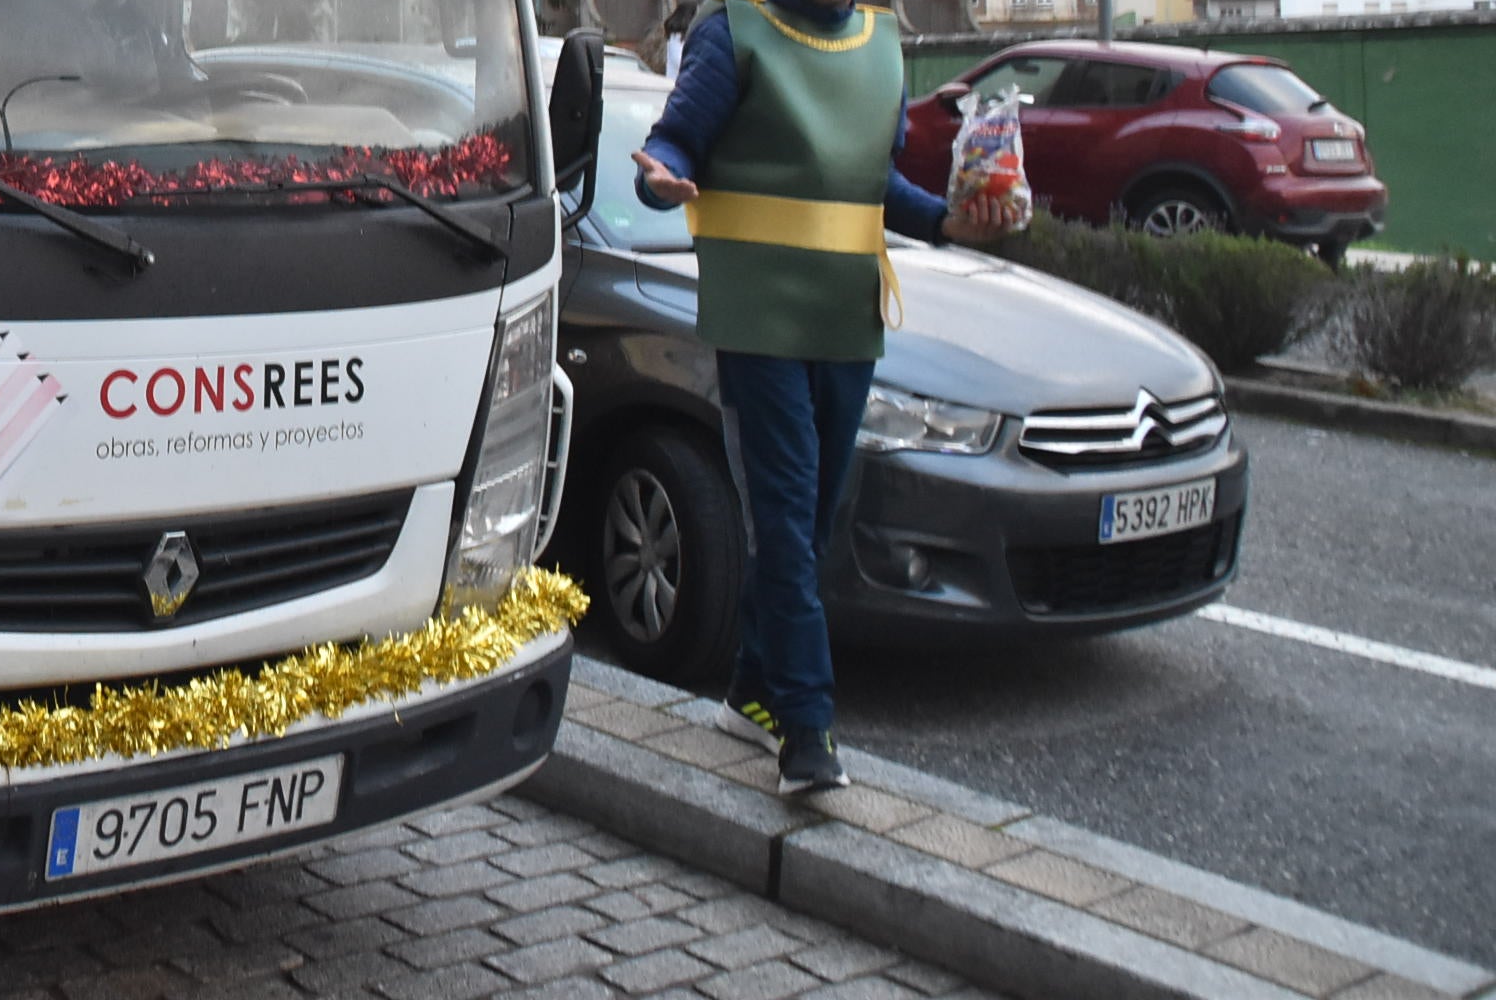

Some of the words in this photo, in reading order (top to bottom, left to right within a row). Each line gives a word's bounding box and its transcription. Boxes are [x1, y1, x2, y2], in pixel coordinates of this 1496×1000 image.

[100, 357, 364, 420] CONSREES
[96, 436, 160, 460] obras,
[167, 430, 253, 455] reformas
[259, 431, 270, 453] y
[275, 418, 364, 452] proyectos
[1115, 494, 1171, 534] 5392
[1177, 485, 1211, 525] HPK
[93, 790, 217, 860] 9705
[237, 769, 325, 833] FNP
